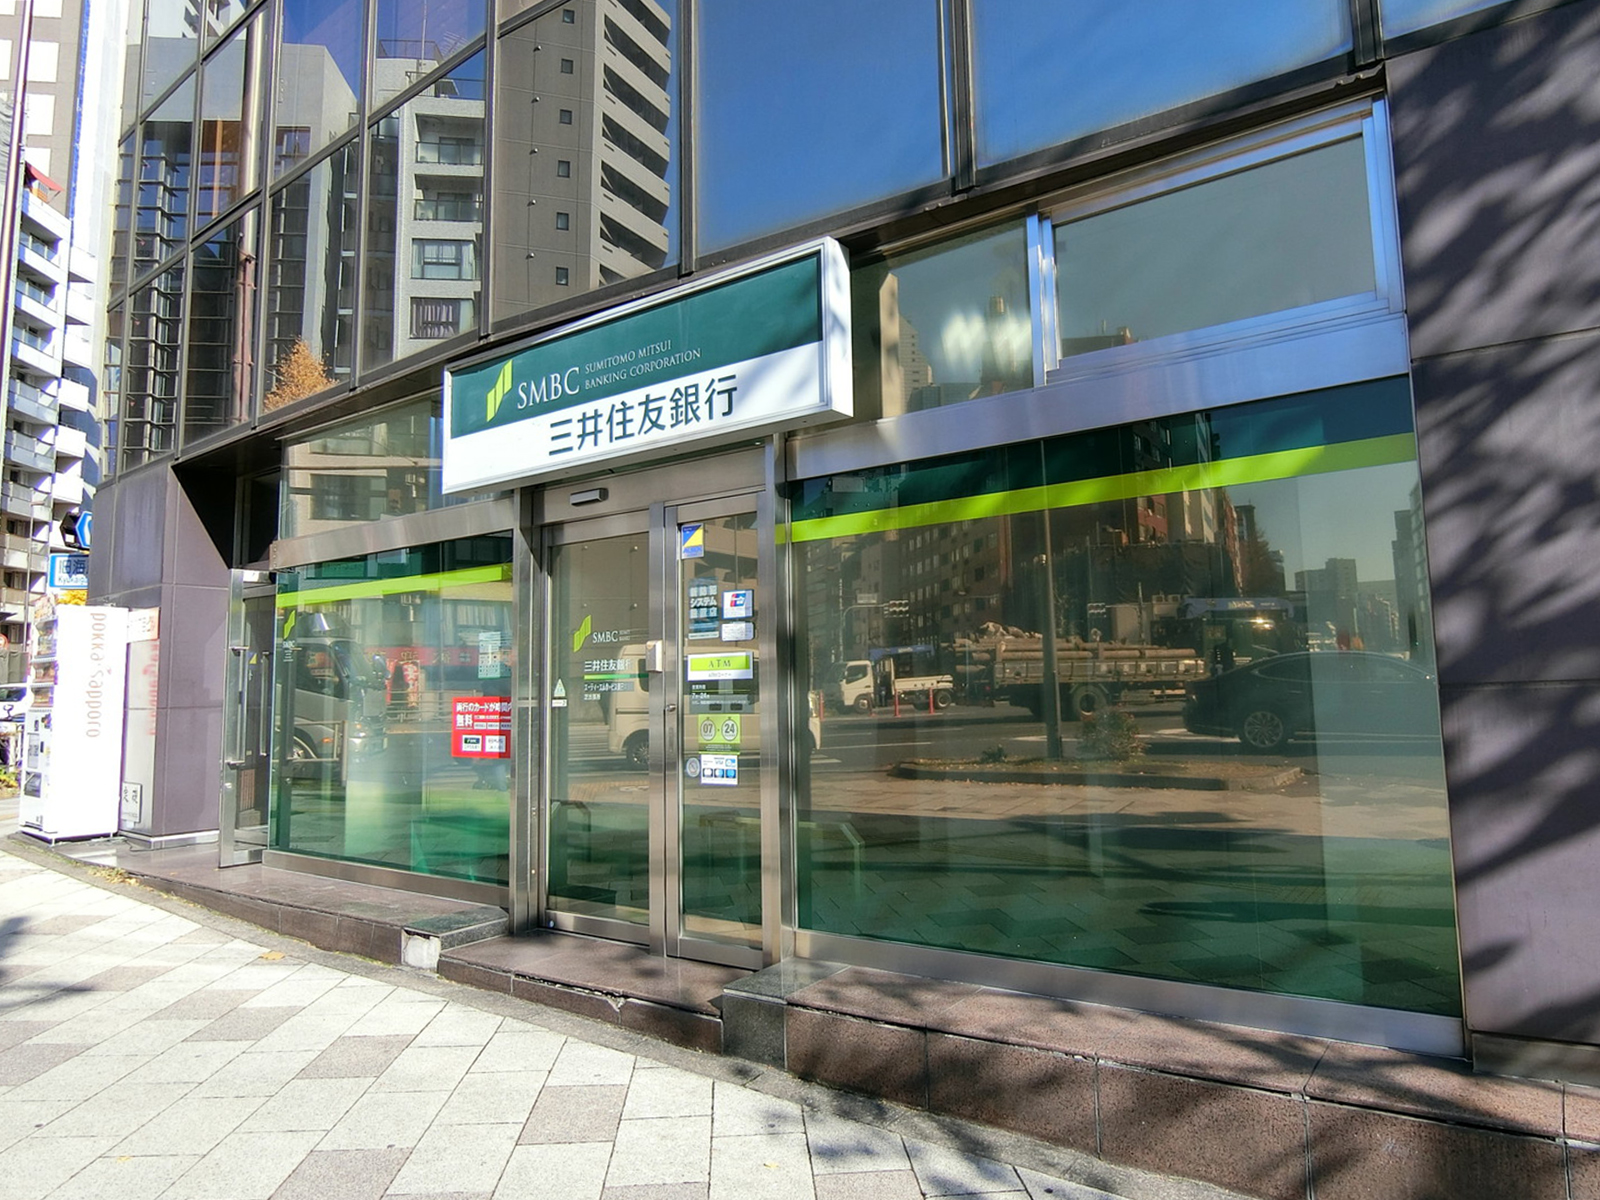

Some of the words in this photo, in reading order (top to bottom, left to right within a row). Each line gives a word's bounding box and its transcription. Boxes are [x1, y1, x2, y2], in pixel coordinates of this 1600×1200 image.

[585, 348, 637, 374] SUMITOMO
[638, 339, 672, 358] MITSUI
[585, 369, 628, 390] BANKING
[629, 347, 702, 377] CORPORATION
[517, 366, 580, 410] SMBC
[549, 374, 738, 456] 三井住友銀行
[58, 558, 88, 574] 旧海
[592, 631, 618, 643] SMBC
[708, 659, 731, 668] ATM
[703, 723, 713, 733] 07
[724, 723, 735, 733] 24
